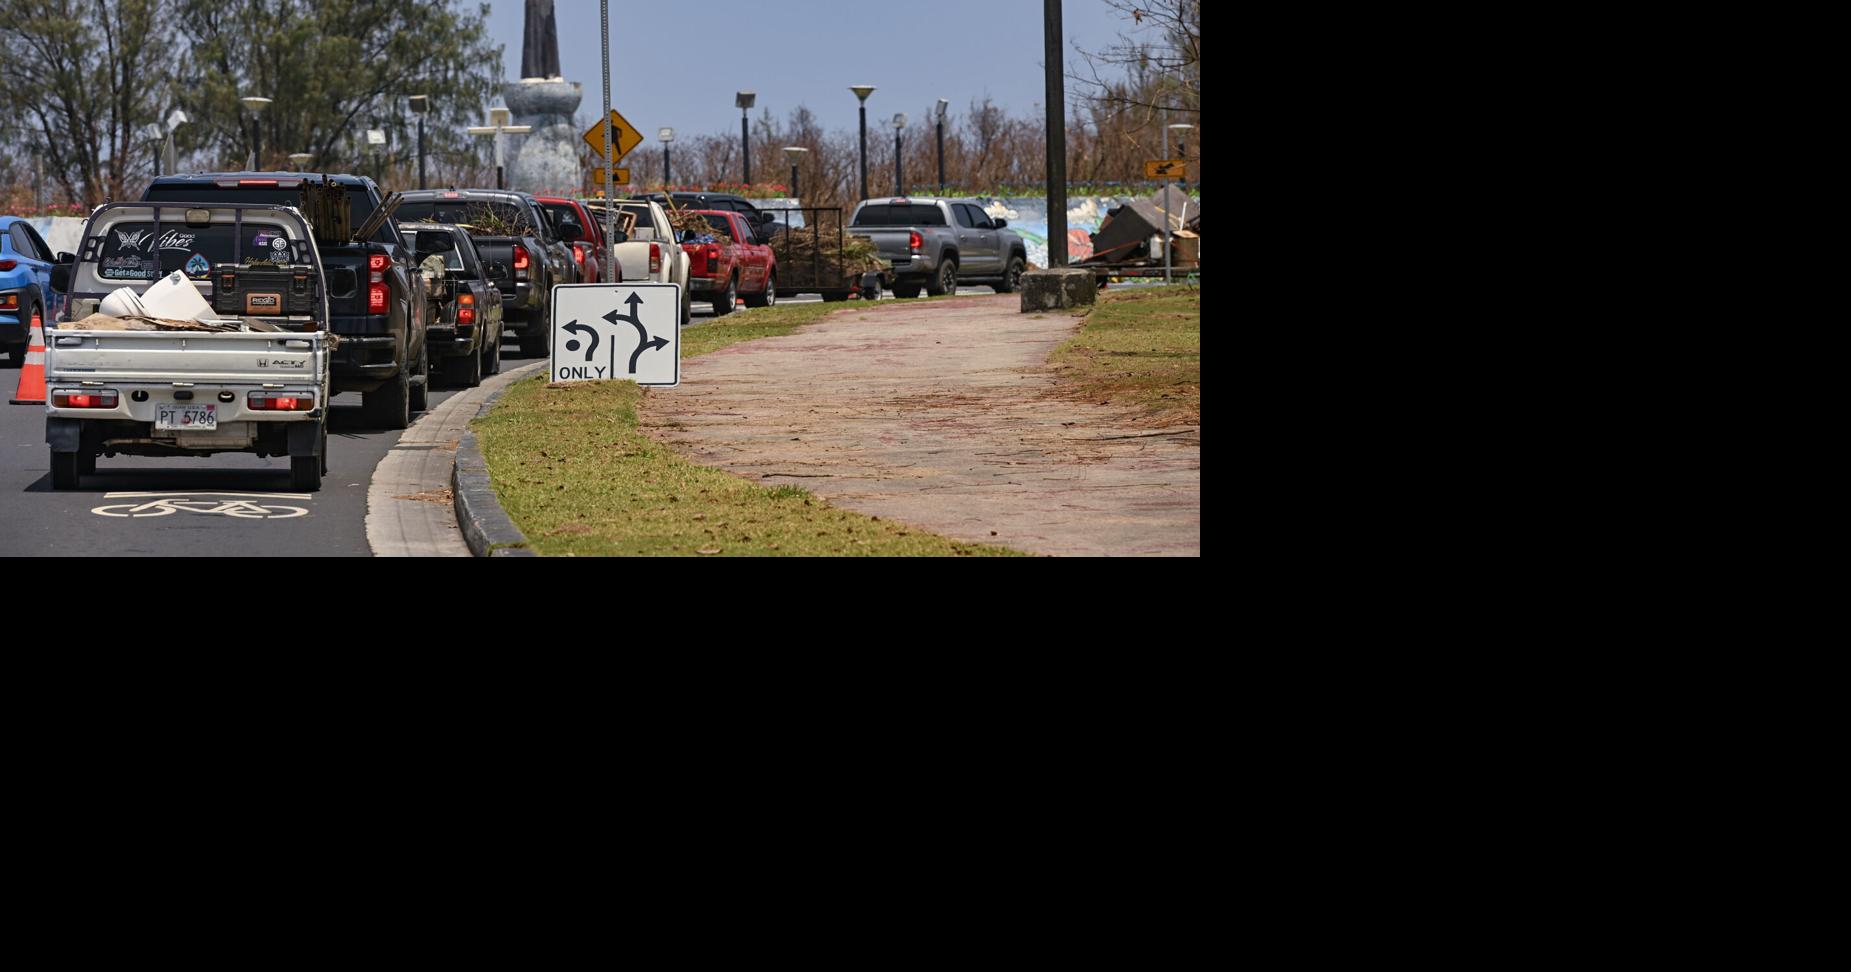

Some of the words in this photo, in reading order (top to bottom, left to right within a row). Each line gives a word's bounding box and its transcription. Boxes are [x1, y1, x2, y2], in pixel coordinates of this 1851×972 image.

[138, 229, 193, 253] Vibes
[114, 269, 126, 277] Get
[130, 269, 147, 277] Good
[559, 366, 606, 379] ONLY
[160, 410, 176, 424] PT
[183, 410, 215, 424] 5786
